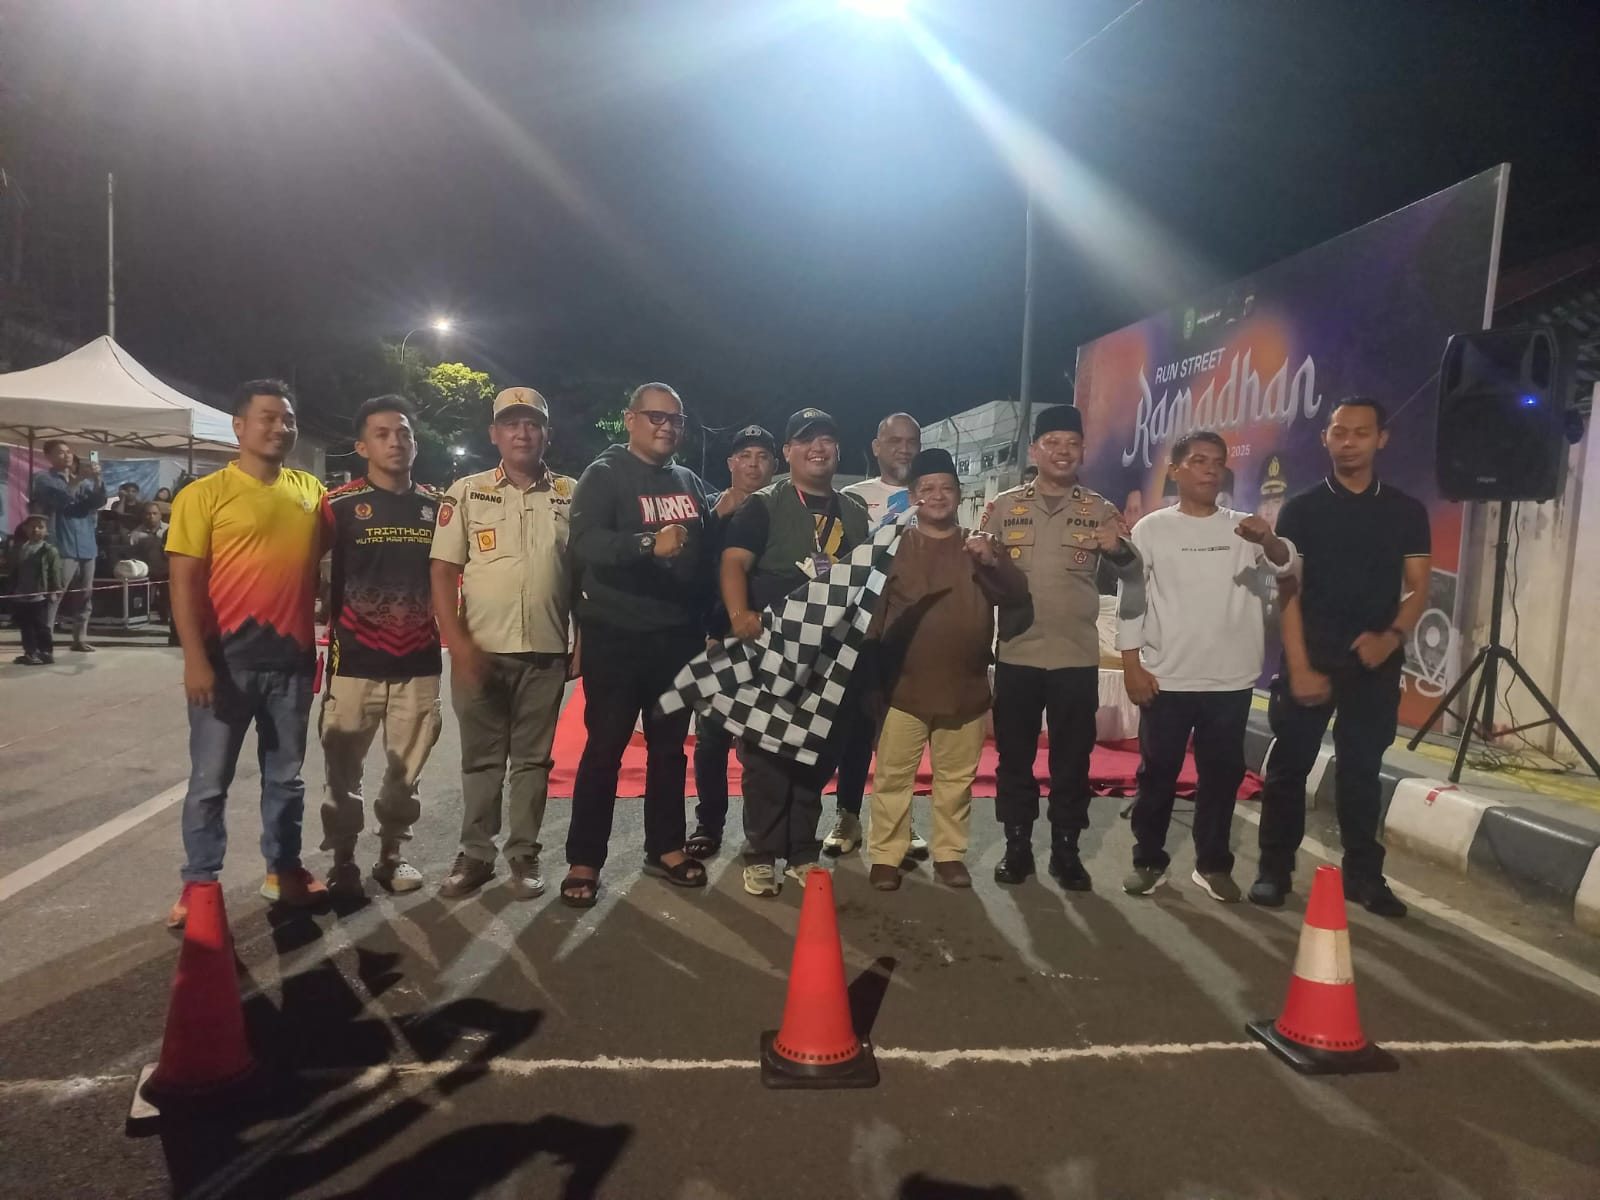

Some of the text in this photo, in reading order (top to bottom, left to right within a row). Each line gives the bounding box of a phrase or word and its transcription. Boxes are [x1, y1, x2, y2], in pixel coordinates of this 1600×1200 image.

[1155, 347, 1226, 385] RUN STREET
[1122, 346, 1322, 468] Ramadhan
[1231, 444, 1251, 457] 2025
[469, 491, 502, 504] ENDANG
[640, 494, 699, 523] MARVEL
[365, 527, 432, 537] TRIATHLON
